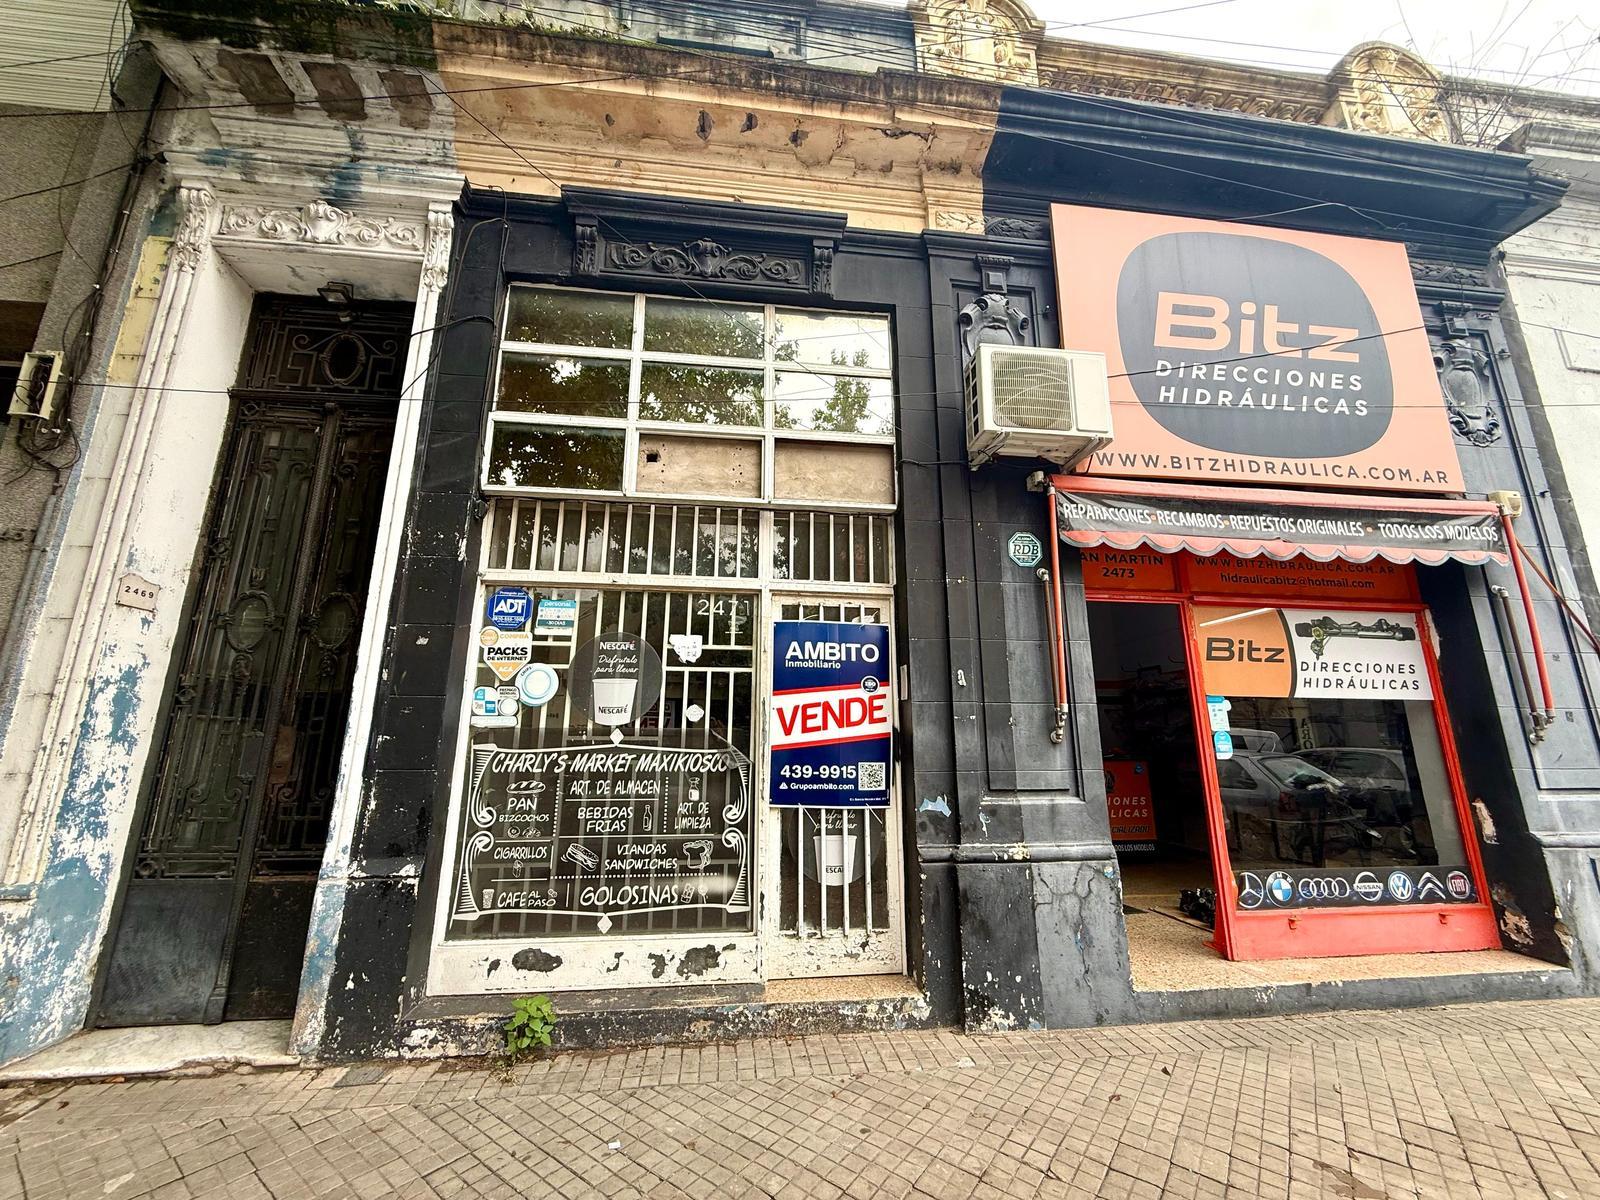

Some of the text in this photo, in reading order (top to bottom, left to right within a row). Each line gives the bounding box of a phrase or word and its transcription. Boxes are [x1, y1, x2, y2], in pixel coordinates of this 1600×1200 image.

[1153, 291, 1360, 363] Bitz
[1155, 360, 1363, 391] DIRECCIONES
[1158, 387, 1368, 417] HIDRÁULICAS
[1095, 451, 1449, 484] WWW.BITZHIDRAULICA.COM.AR
[1063, 503, 1499, 542] REPARACIONES RECAMBIOS REPUESTOS ORIGINALES TODOS LOS MODELOS
[1013, 544, 1039, 555] RDB
[1080, 552, 1164, 565] AN MARTIN
[1102, 567, 1135, 578] 2473
[124, 586, 154, 599] 2469
[494, 599, 527, 614] ADT
[697, 599, 750, 616] 2471
[487, 647, 528, 656] PACKS
[600, 640, 636, 650] NESCAFÉ
[1205, 637, 1285, 663] Bitz
[785, 641, 880, 663] AMBITO
[598, 654, 638, 668] Disfrutalo
[785, 660, 841, 669] Inmobiliario
[1300, 661, 1416, 674] DIRECCIONES
[593, 664, 639, 675] para llevar
[1303, 676, 1420, 690] HIDRÁULICAS
[598, 704, 629, 715] NESCAFÉ
[776, 693, 888, 736] VENDE
[492, 752, 569, 773] CHARLY'S
[570, 753, 637, 773] MARKET
[780, 764, 857, 779] 439-9915
[570, 780, 661, 796] ART. DE ALMACEN
[790, 782, 855, 791] Grupoambito.com
[507, 796, 538, 811] PAN
[676, 802, 710, 816] ART. DE
[498, 814, 550, 822] BIZCOCHOS
[578, 806, 634, 819] BEBIDAS
[586, 820, 627, 833] FRIAS
[674, 816, 711, 829] LIMPIEZA
[493, 846, 548, 860] CIGARRILLOS
[617, 843, 667, 855] VIANDAS
[604, 858, 678, 871] SANDWICHES
[1451, 879, 1466, 892] FIAT
[497, 891, 527, 908] CAFE
[528, 890, 541, 898] AL
[580, 884, 679, 906] GOLOSINAS
[527, 898, 556, 907] PASO
